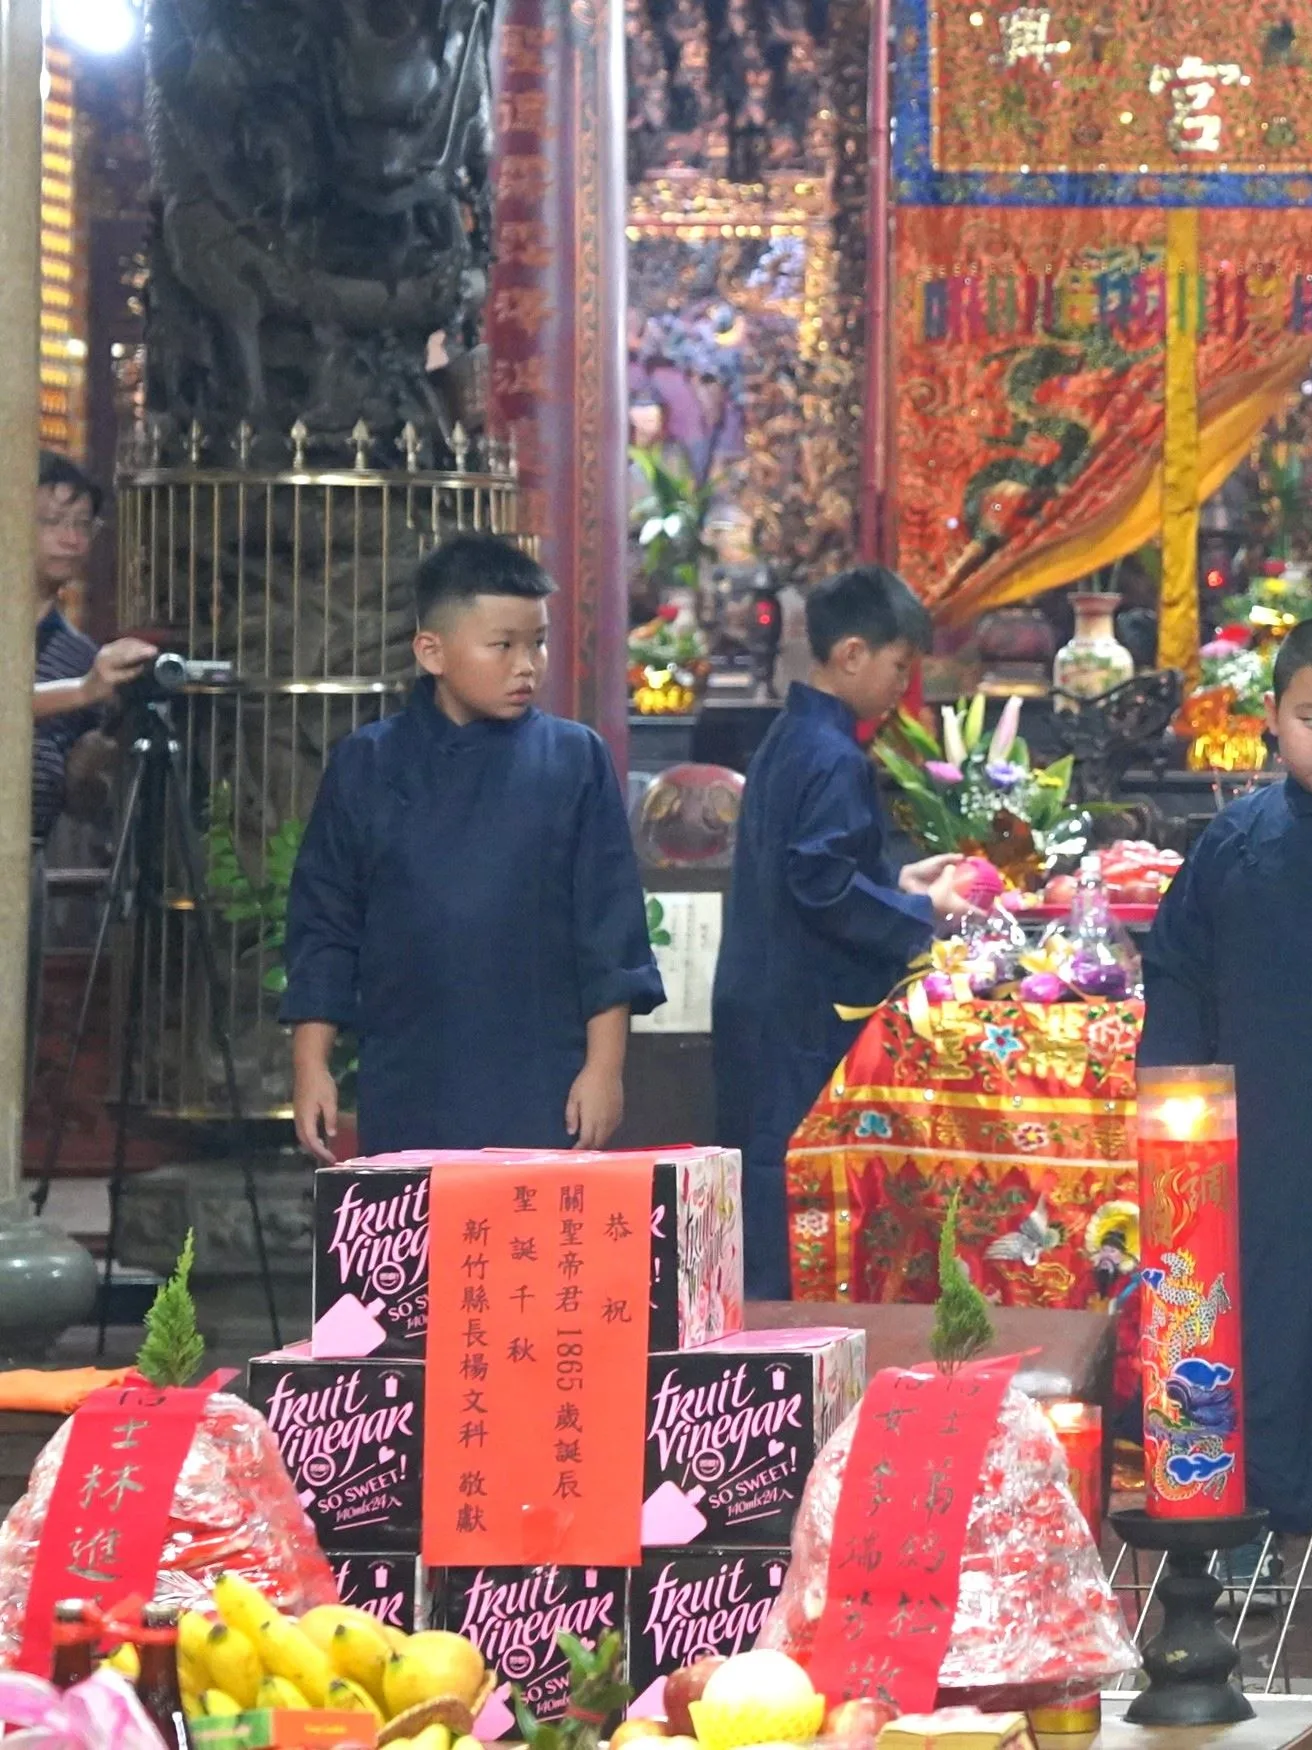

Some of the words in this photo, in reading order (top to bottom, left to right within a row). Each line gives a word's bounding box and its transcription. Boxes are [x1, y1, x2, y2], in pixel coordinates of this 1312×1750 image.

[327, 1177, 429, 1254] fruit
[334, 1223, 429, 1286] Vineg
[506, 1185, 538, 1364] 聖誕千秋
[601, 1211, 633, 1325] 恭祝
[265, 1368, 369, 1431] fruit
[647, 1362, 756, 1441] fruit
[317, 1494, 342, 1514] SO
[344, 1454, 407, 1503] SWEET!
[708, 1490, 733, 1510] SO
[735, 1446, 798, 1498] SWEET!
[458, 1563, 569, 1636] fruit
[642, 1557, 753, 1636] fruit
[651, 1597, 777, 1667] Vinega
